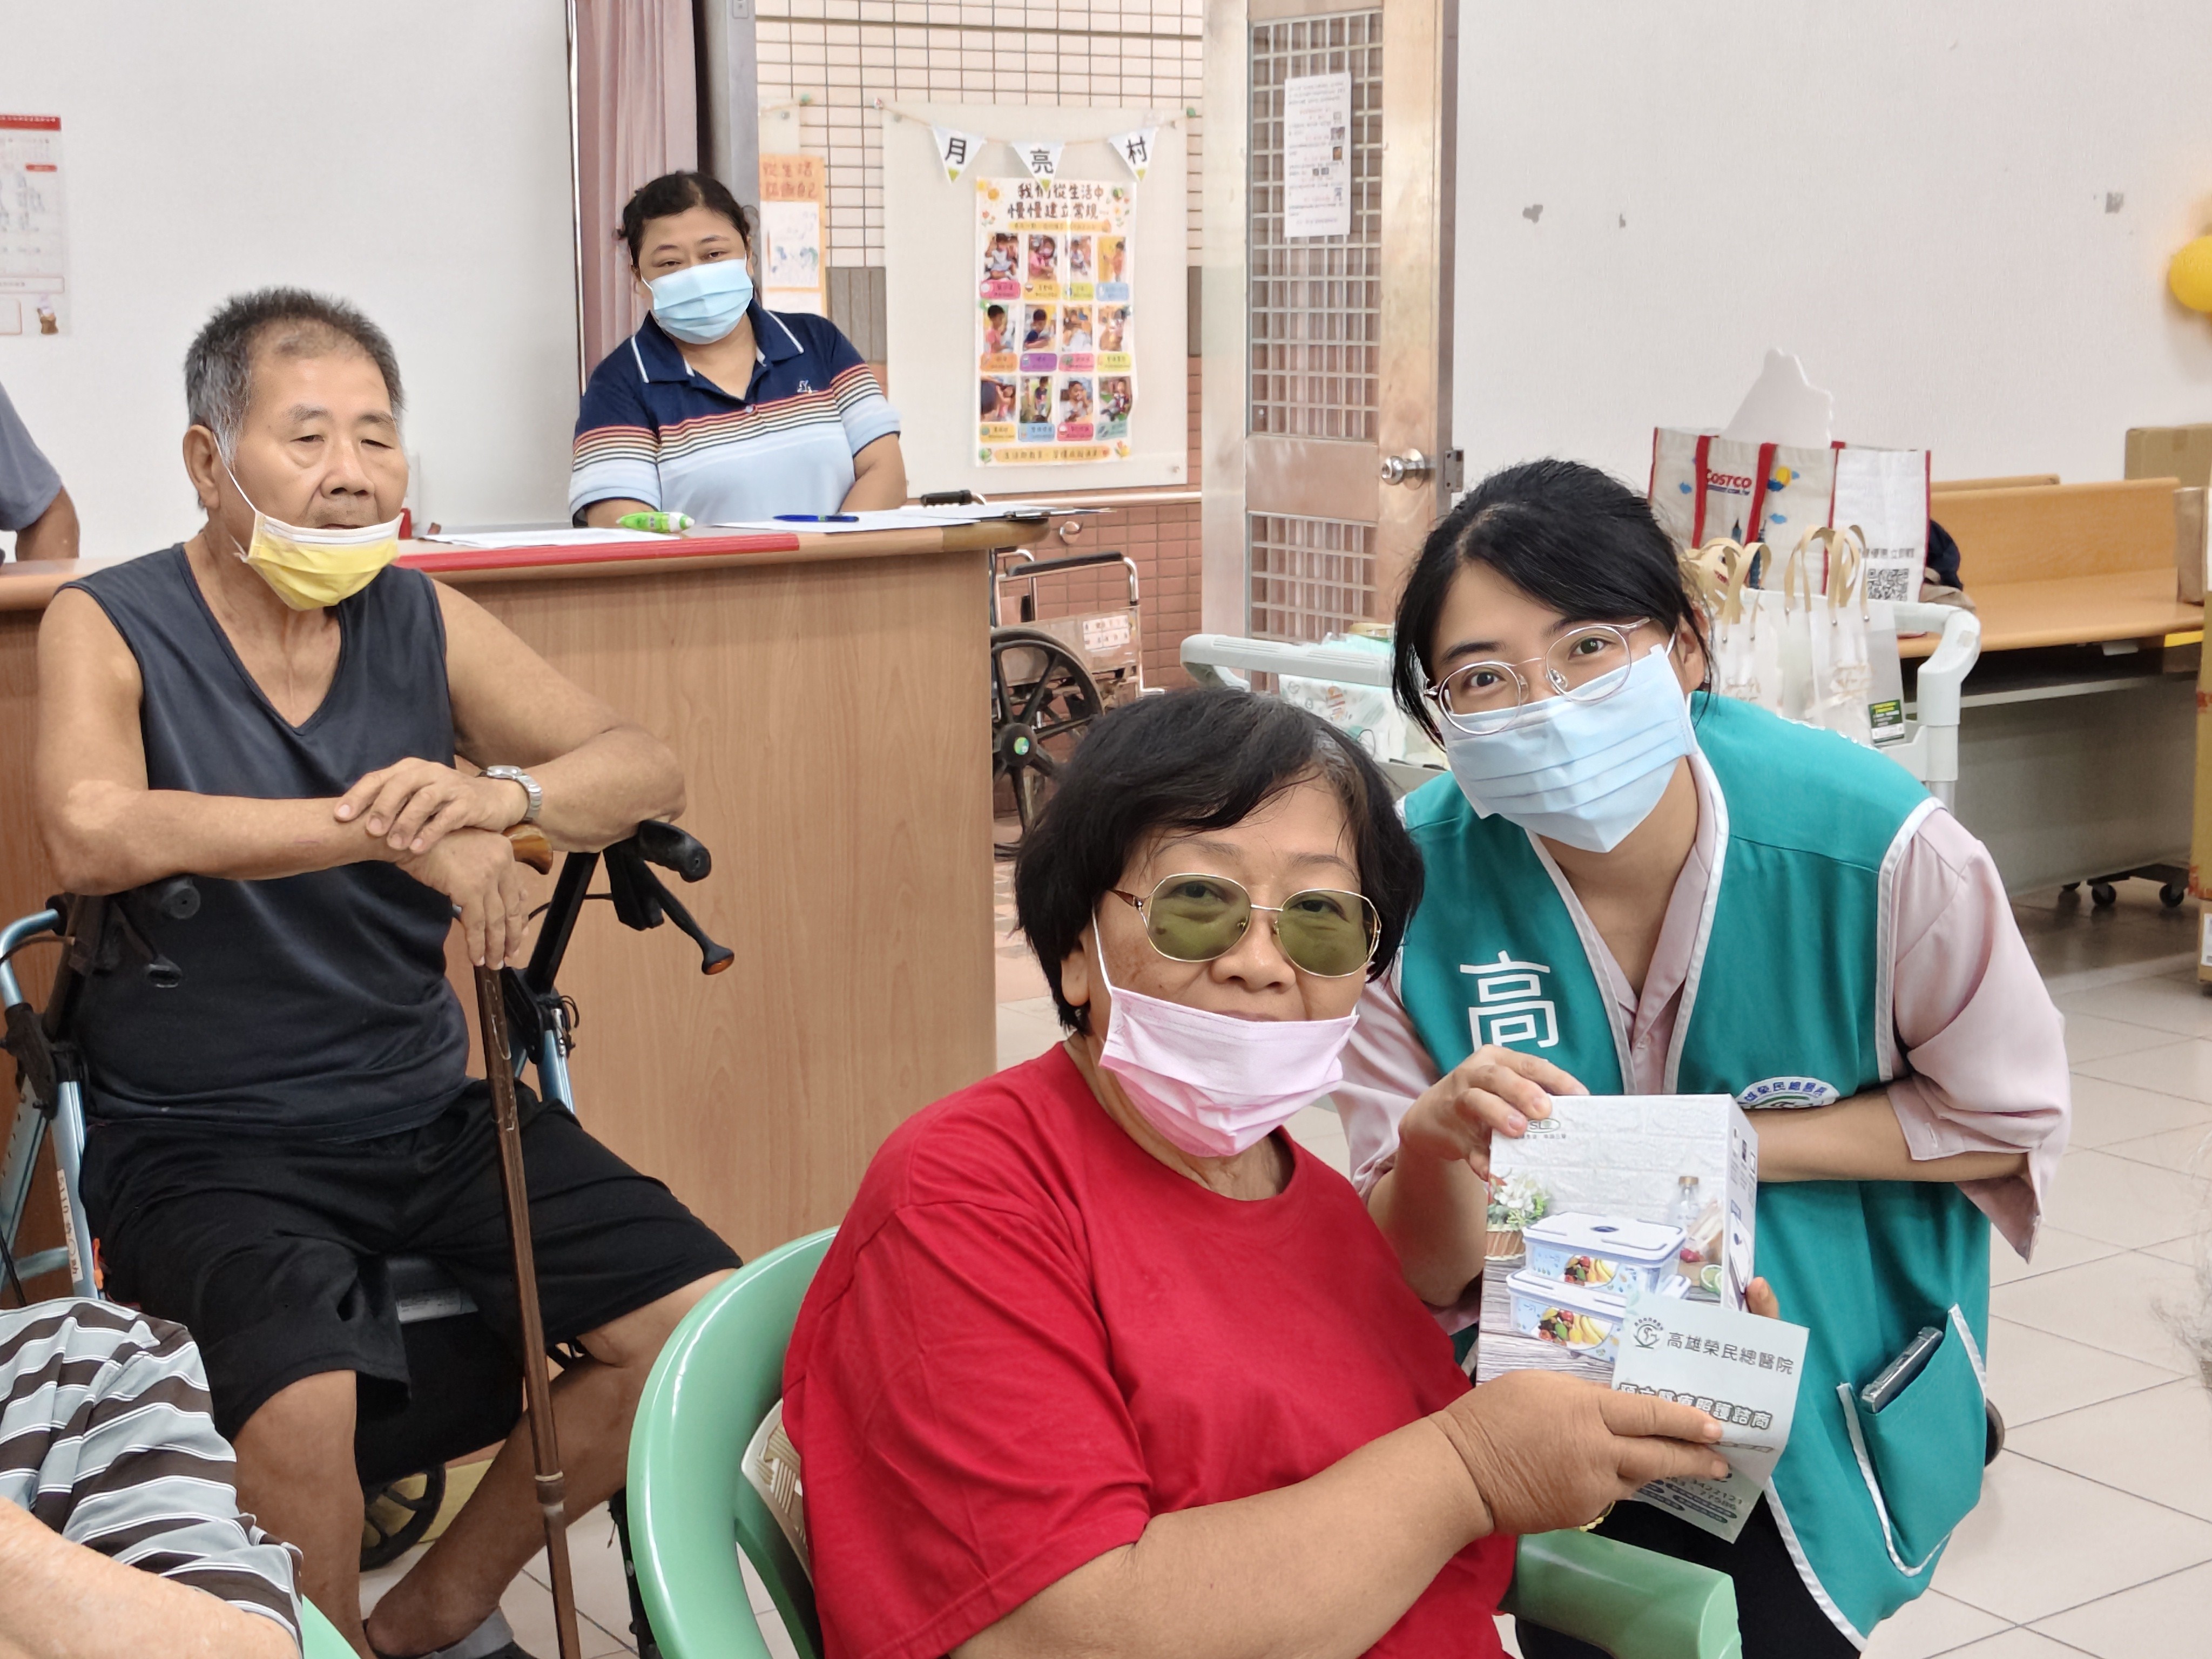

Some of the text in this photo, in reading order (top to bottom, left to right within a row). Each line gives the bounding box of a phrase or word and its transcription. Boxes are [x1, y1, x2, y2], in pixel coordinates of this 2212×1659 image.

[945, 136, 1147, 174] 月 亮 村
[1459, 950, 1559, 1052] 高
[1667, 1332, 1794, 1375] 高雄榮民總醫院
